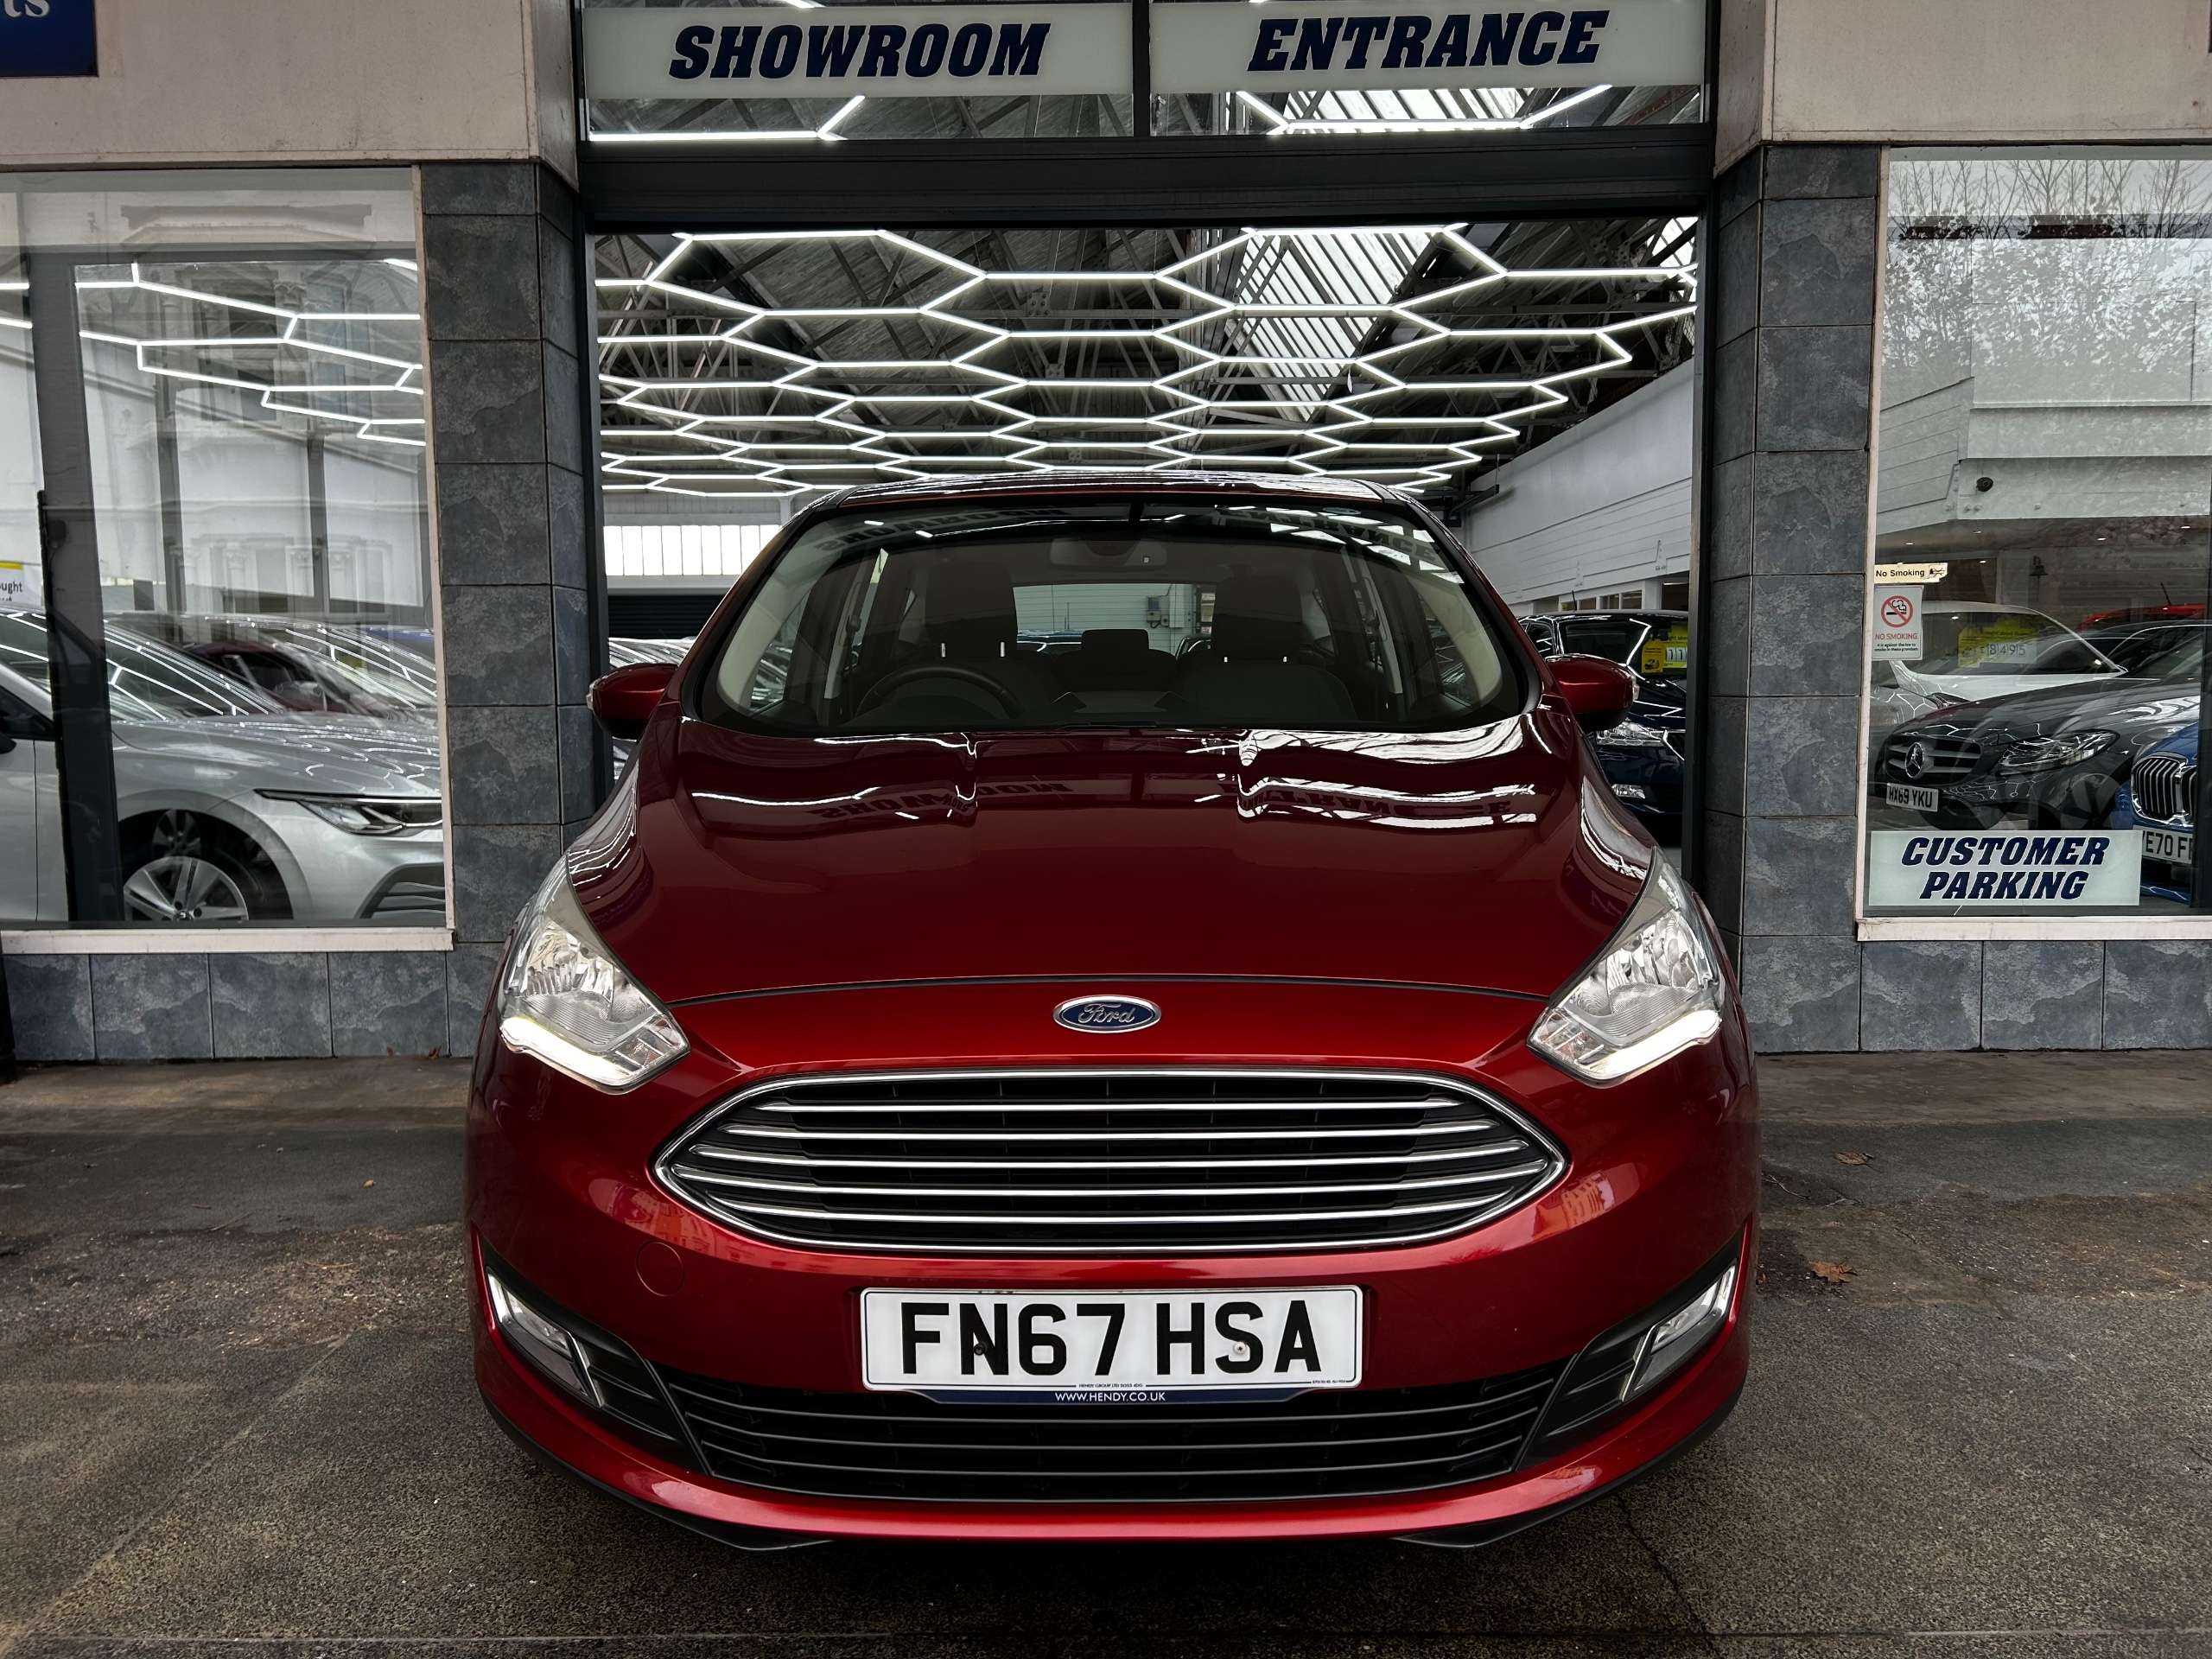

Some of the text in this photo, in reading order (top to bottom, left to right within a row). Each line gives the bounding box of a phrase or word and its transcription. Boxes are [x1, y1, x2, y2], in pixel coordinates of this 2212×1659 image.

[668, 10, 1610, 79] SHOWROOM ENTRANCE
[1890, 569, 1925, 578] Smoking
[0, 581, 22, 594] ught
[1912, 789, 1933, 808] YKU
[1901, 836, 2110, 865] CUSTOMER
[1919, 870, 2089, 899] PARKING
[1077, 1003, 1136, 1024] Ford
[901, 1300, 1321, 1376] FN67 HSA
[1054, 1392, 1166, 1402] WWW.HENDY.CO.UK
